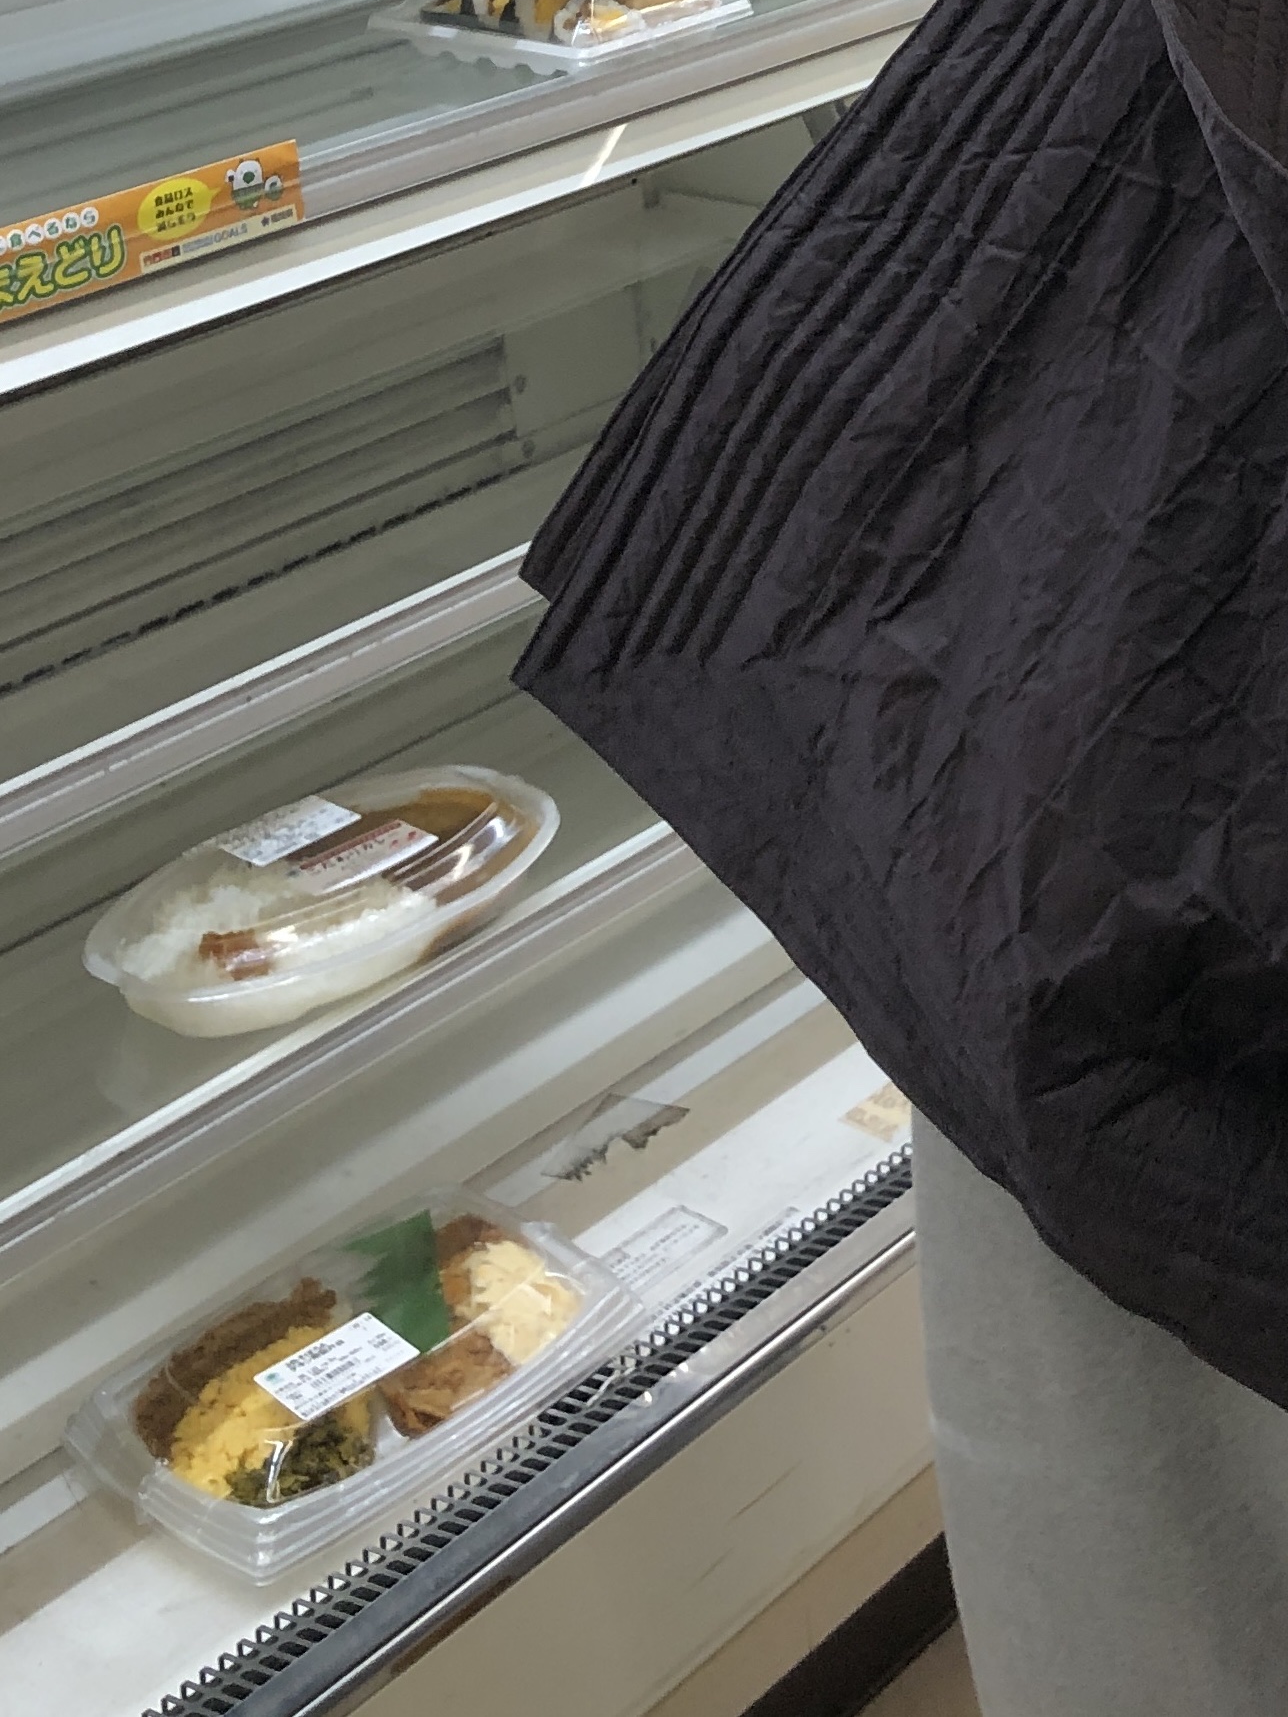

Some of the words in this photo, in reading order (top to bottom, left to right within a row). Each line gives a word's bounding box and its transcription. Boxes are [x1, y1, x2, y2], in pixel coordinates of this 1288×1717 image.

[154, 186, 194, 208] 食品ロス
[155, 199, 194, 220] みんなで
